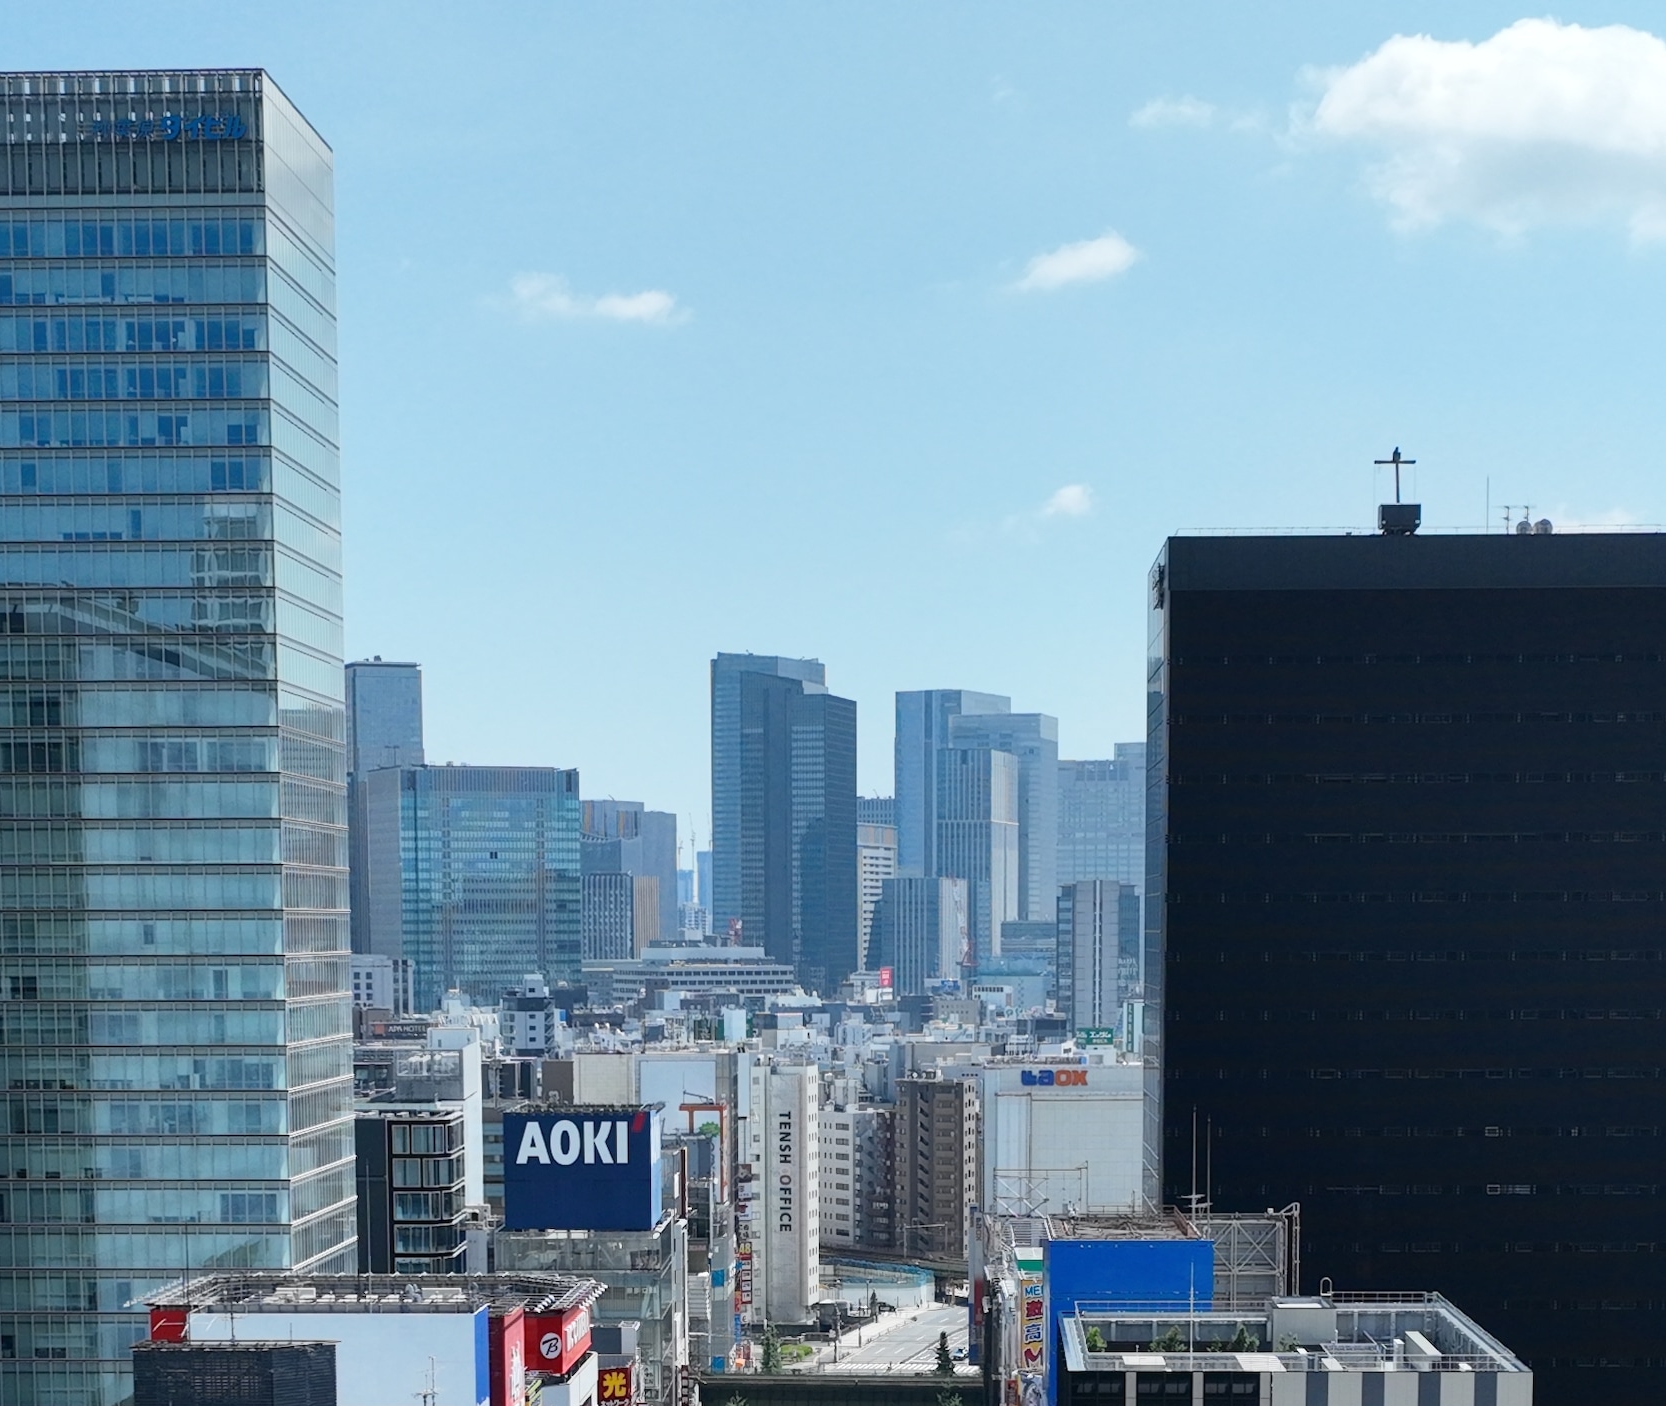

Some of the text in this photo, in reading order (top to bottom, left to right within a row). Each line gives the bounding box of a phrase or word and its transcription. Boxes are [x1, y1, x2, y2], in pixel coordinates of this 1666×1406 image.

[516, 1119, 629, 1166] AOKI
[779, 1175, 792, 1232] OFFICE
[603, 1371, 627, 1399] 光
